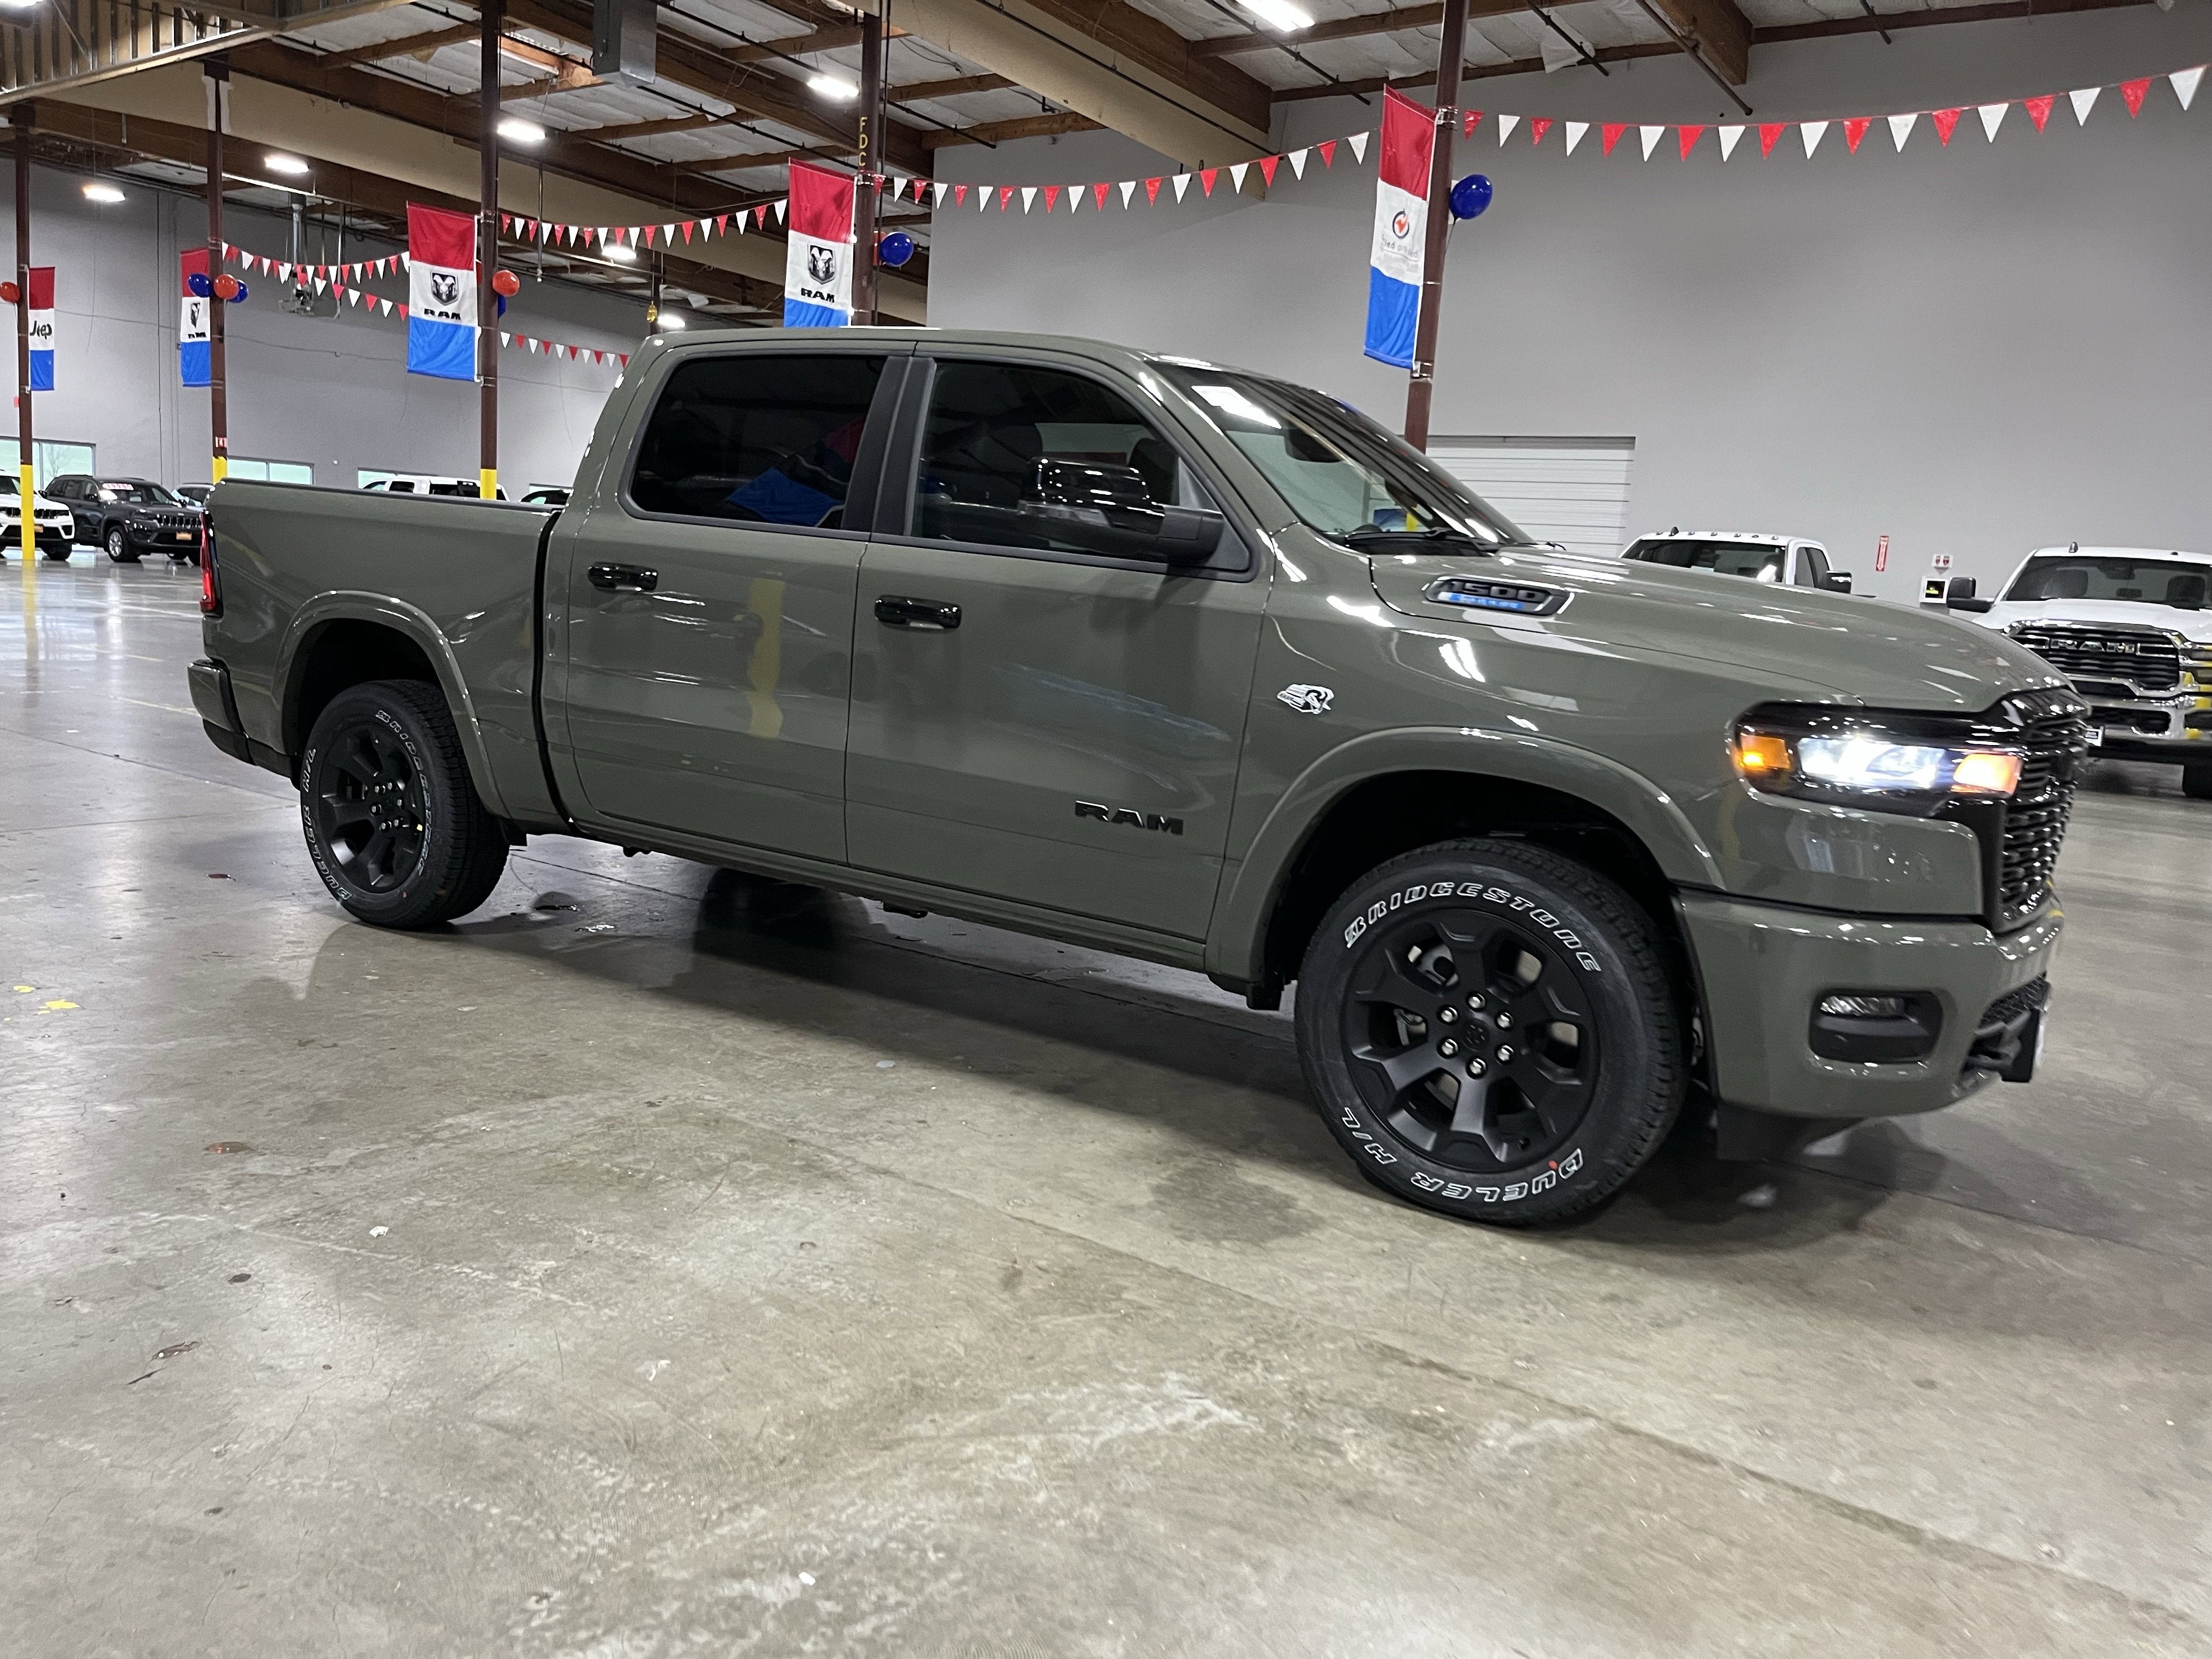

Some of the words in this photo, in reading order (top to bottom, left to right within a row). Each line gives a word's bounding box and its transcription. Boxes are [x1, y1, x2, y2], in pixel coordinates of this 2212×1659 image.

[801, 287, 834, 303] RAM
[424, 308, 461, 320] RAM
[1451, 581, 1545, 603] 1500
[2051, 639, 2135, 654] RAM
[1074, 800, 1184, 835] RAM
[303, 805, 352, 900] DUELER
[1344, 882, 1601, 972] BRIDGESTONE
[1410, 1148, 1583, 1202] DUELER
